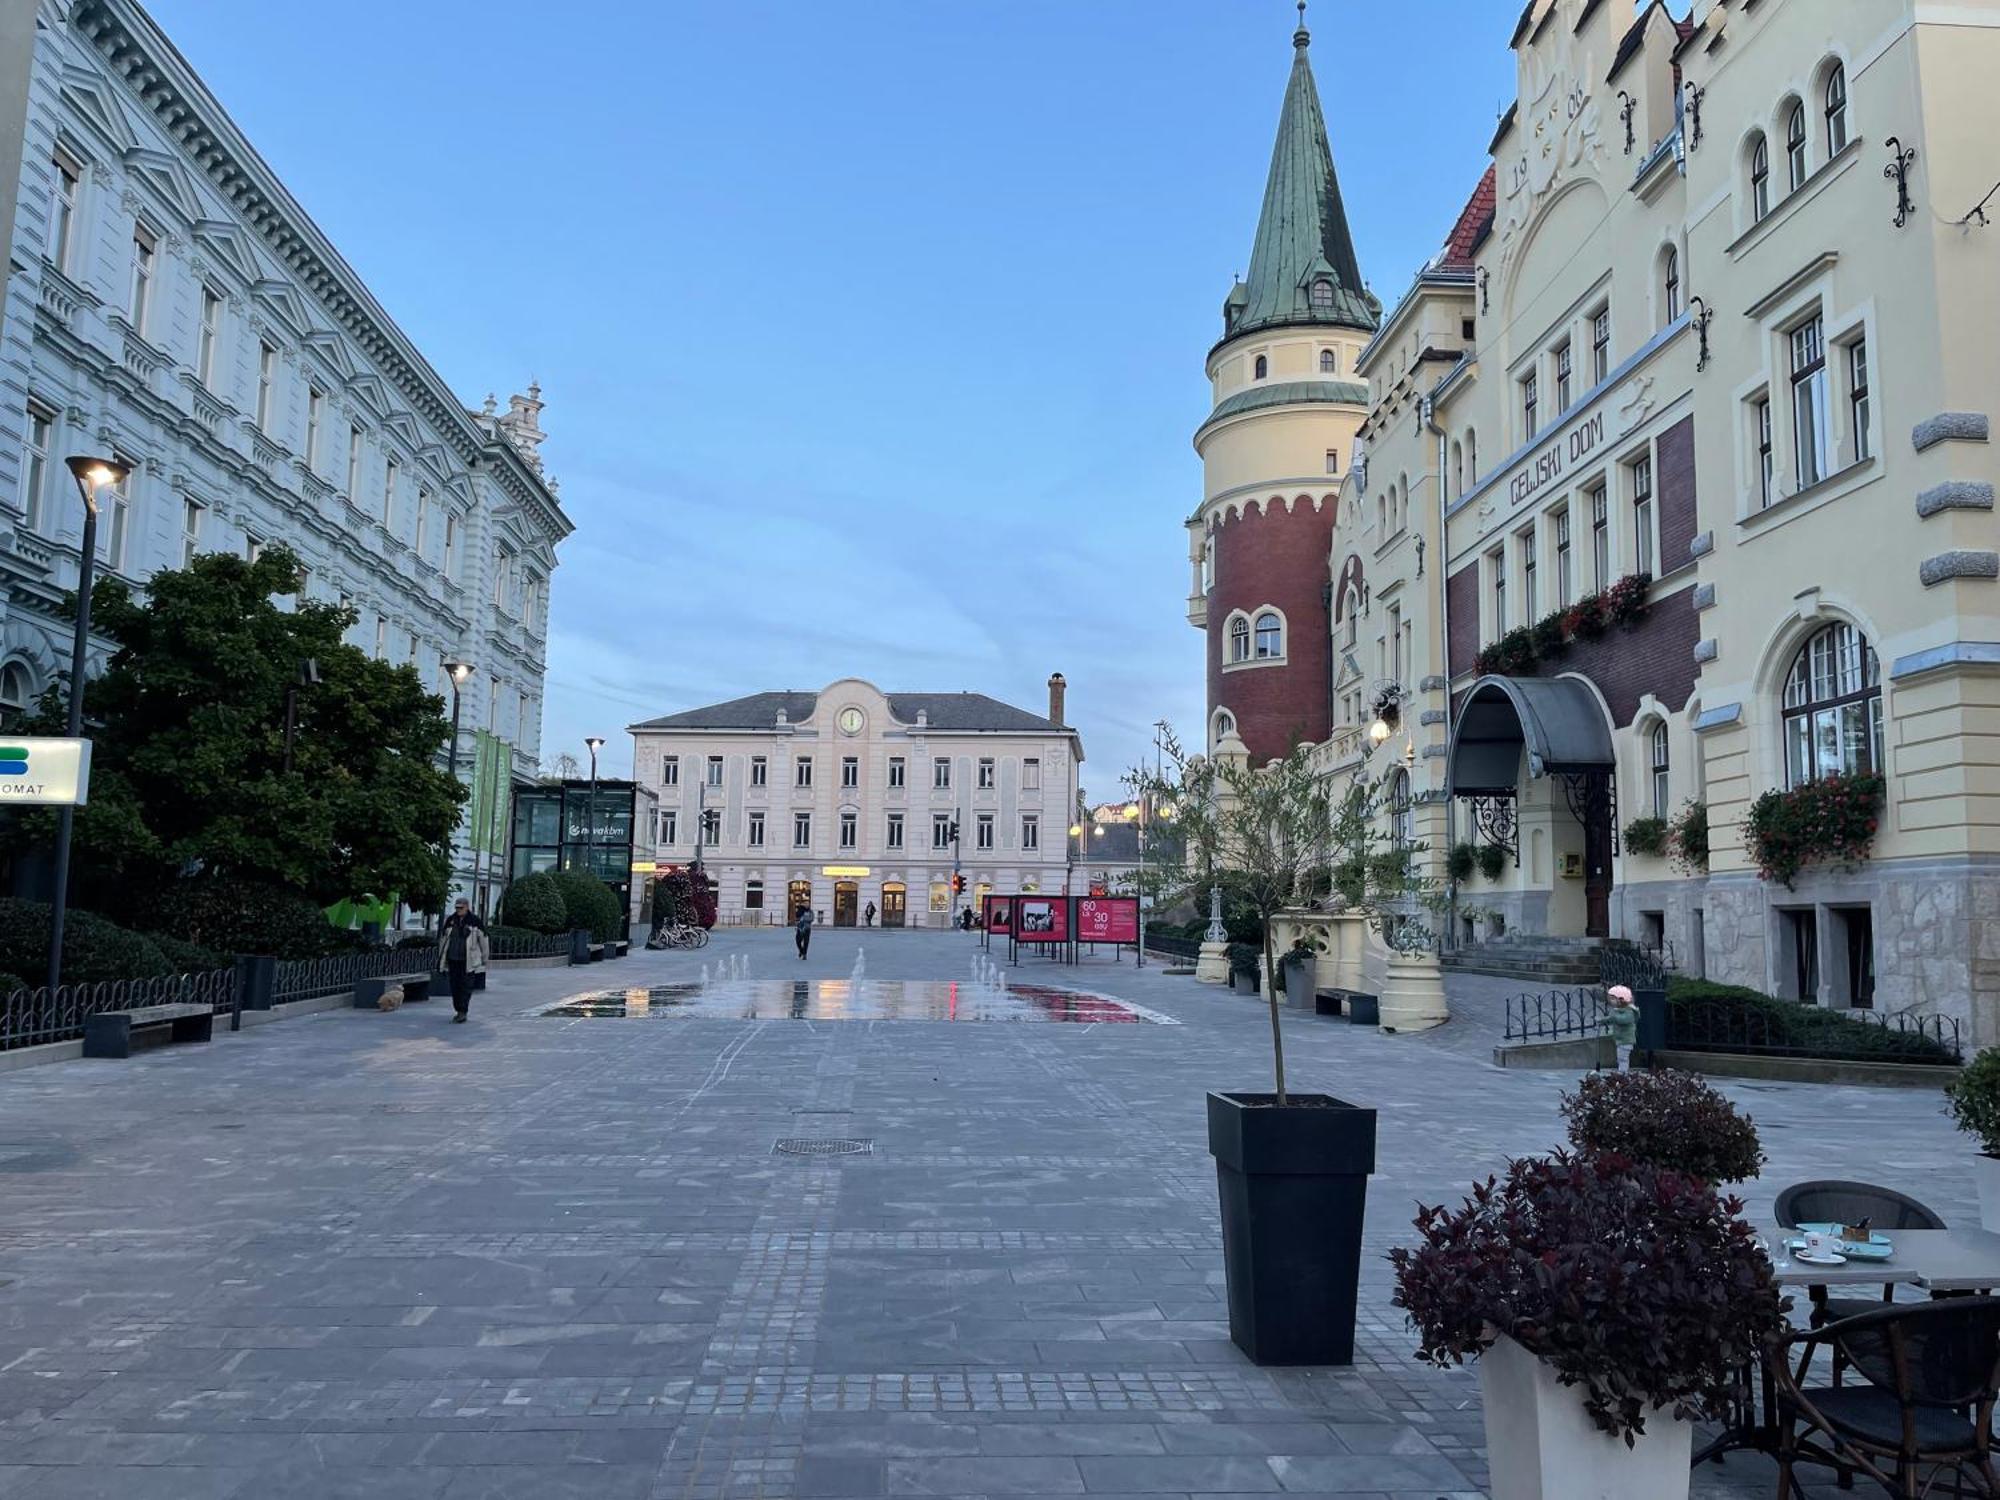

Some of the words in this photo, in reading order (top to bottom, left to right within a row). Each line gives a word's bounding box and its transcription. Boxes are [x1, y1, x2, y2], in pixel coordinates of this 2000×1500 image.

[1510, 443, 1562, 507] CELJSKI
[1569, 411, 1604, 464] DOM
[1082, 900, 1096, 911] 60
[1094, 911, 1108, 923] 30
